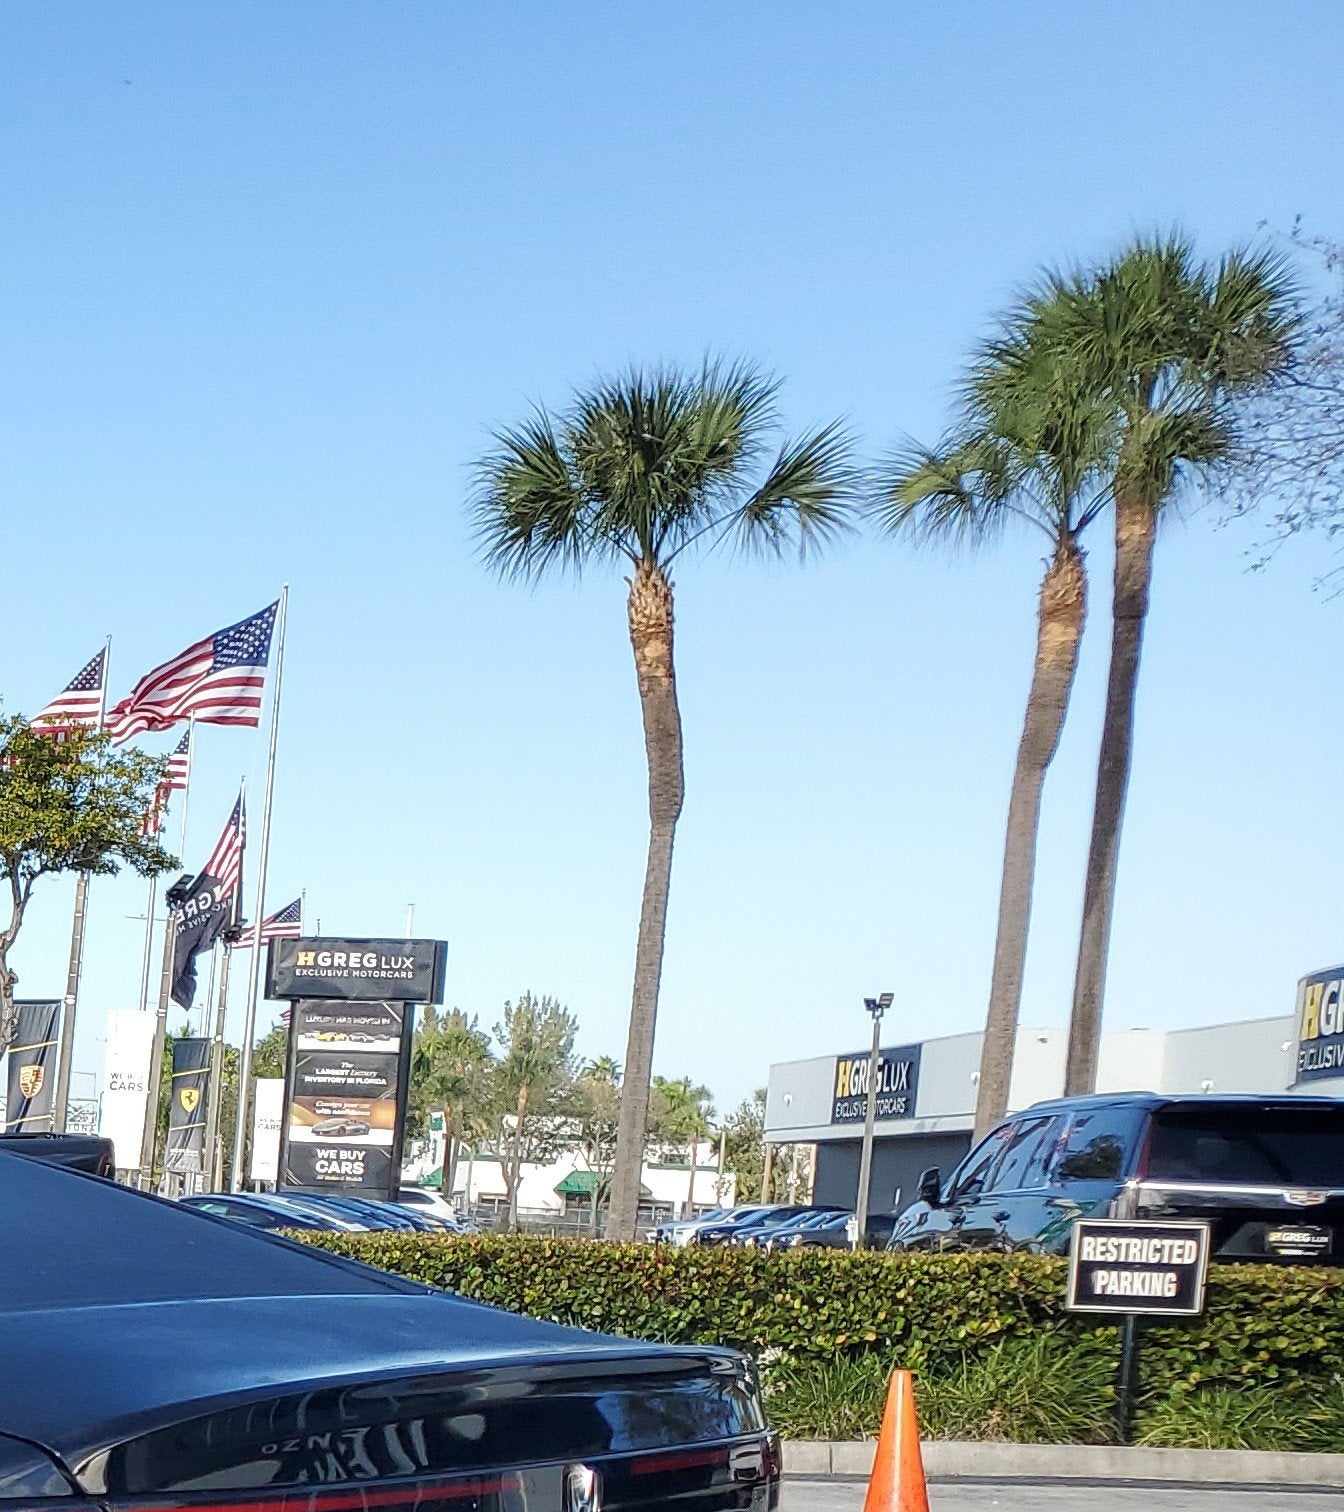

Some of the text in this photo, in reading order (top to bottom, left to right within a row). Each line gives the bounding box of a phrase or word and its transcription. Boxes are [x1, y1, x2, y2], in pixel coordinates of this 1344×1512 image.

[297, 951, 415, 969] HGREG LUX
[295, 969, 413, 979] EXCLUSIVE MOTORCARS
[883, 1061, 910, 1093] LUX
[110, 1081, 143, 1091] CARS
[317, 1149, 366, 1160] WE BUY
[315, 1160, 365, 1175] CARS
[1080, 1236, 1198, 1265] RESTRICTED
[1094, 1271, 1177, 1298] PARKING
